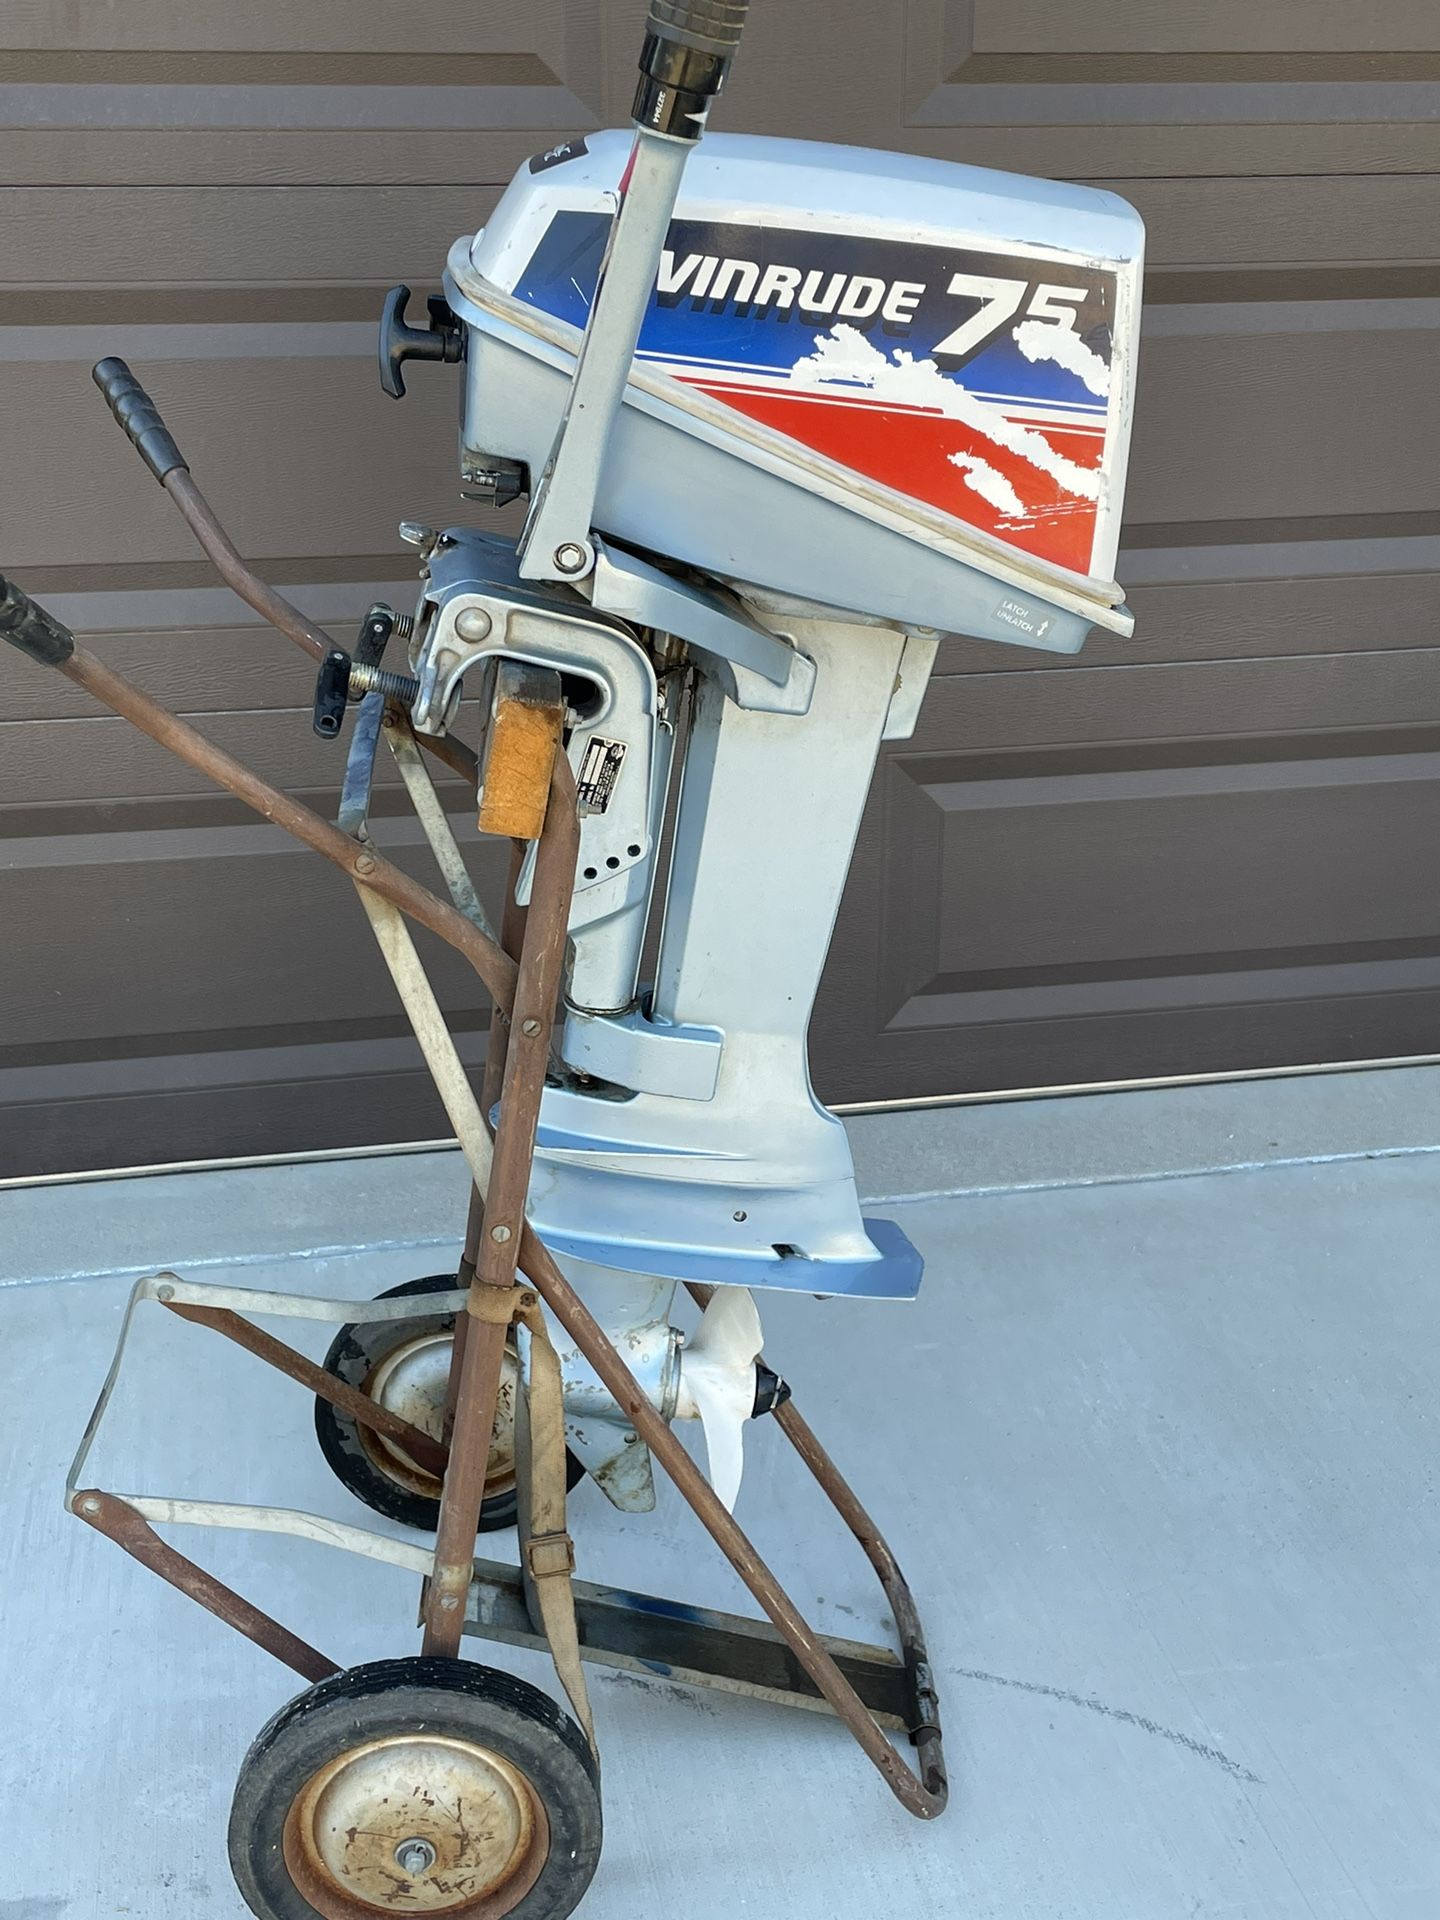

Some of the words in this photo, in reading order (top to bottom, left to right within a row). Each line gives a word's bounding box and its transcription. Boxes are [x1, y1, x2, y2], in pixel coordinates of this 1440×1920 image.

[656, 250, 926, 323] VINRUDE
[1002, 601, 1029, 617] LATCH
[996, 610, 1034, 632] UNLATCH
